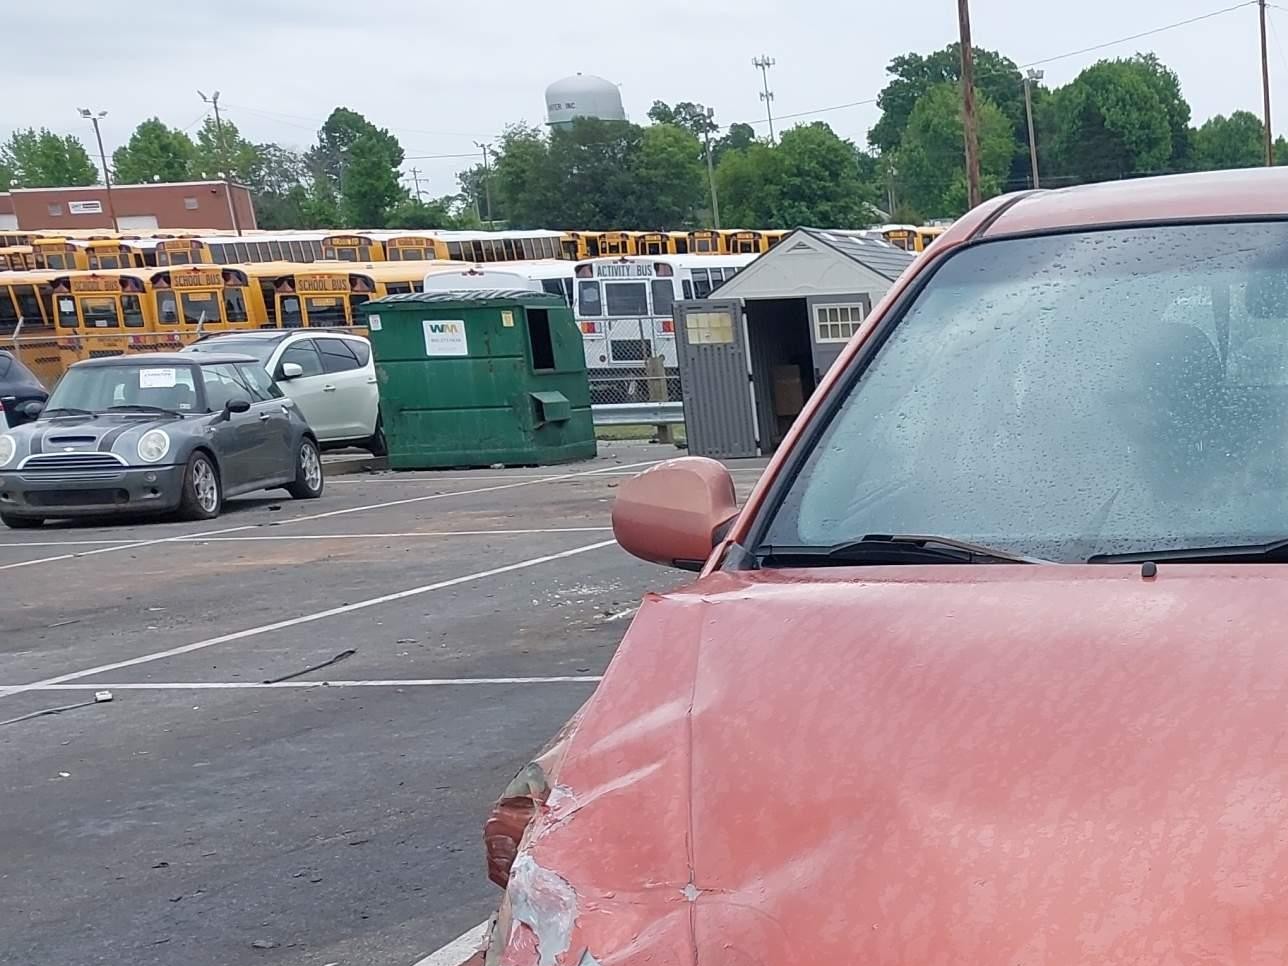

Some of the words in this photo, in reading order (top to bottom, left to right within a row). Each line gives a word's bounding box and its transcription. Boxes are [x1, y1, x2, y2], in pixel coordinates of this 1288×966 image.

[596, 264, 631, 277] ACTIVITY
[636, 264, 653, 277] BUS
[73, 280, 100, 291] SCHOOL
[104, 280, 119, 291] BUS
[173, 275, 201, 287] SCHOOL
[205, 274, 221, 285] BUS
[298, 278, 328, 291] SCHOOL
[332, 278, 347, 291] BUS
[428, 324, 458, 333] WM
